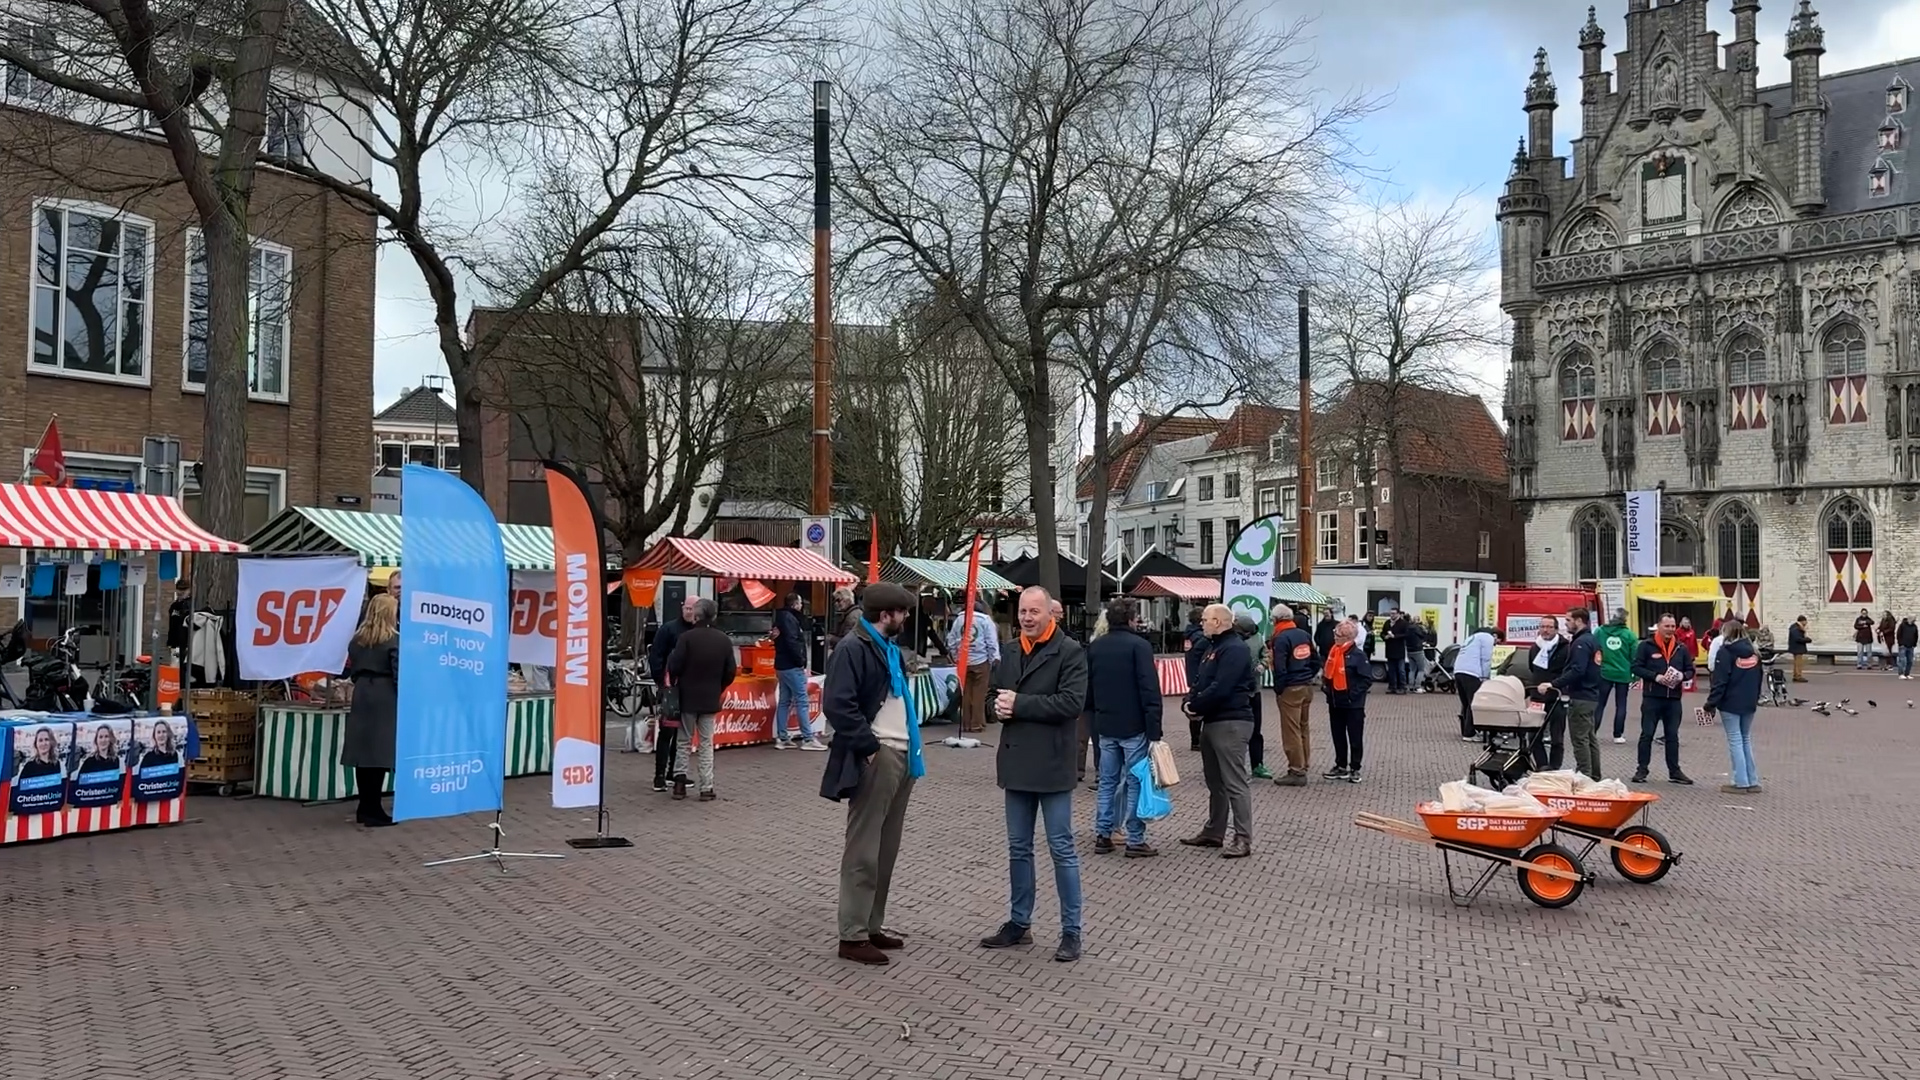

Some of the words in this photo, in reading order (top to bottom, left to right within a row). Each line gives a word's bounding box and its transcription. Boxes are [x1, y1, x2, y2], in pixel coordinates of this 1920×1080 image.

[1628, 496, 1641, 552] Vleeshal
[1232, 567, 1251, 577] Partij
[1241, 578, 1264, 587] Dieren
[253, 588, 347, 646] SGP
[138, 779, 180, 791] ChristenUnie
[17, 791, 62, 803] ChristenUnie
[75, 786, 119, 797] ChristenUnie
[1547, 798, 1576, 811] SGP
[1457, 817, 1488, 830] SGP
